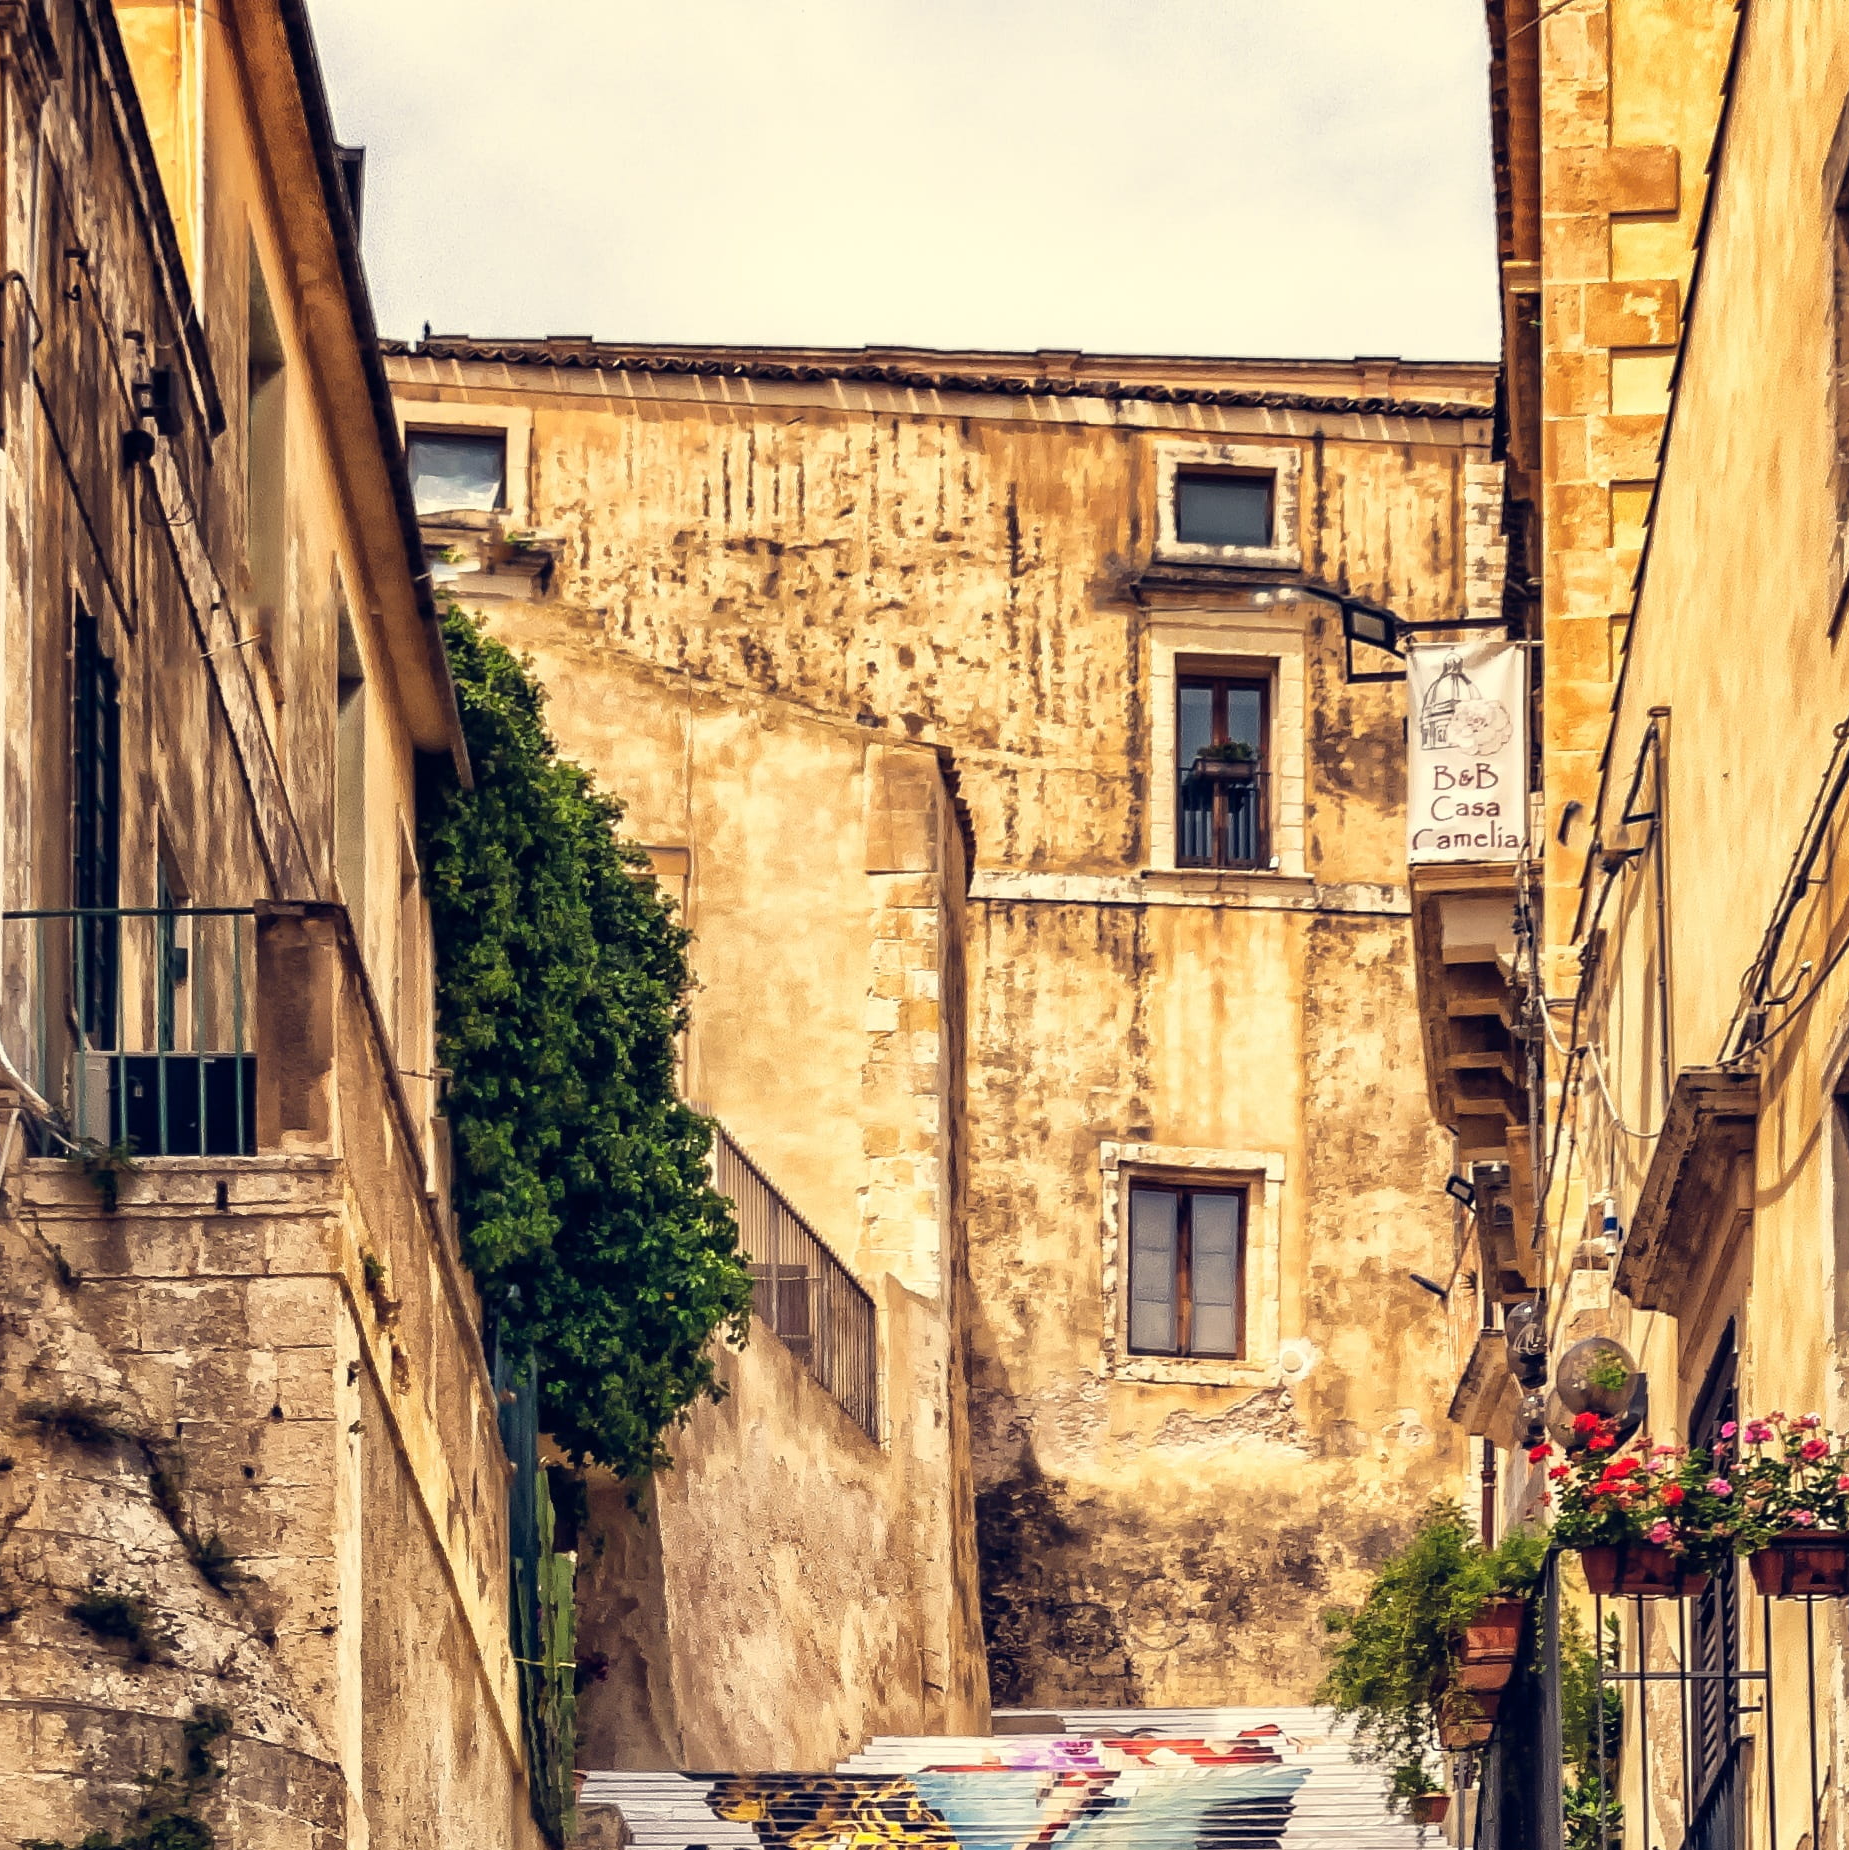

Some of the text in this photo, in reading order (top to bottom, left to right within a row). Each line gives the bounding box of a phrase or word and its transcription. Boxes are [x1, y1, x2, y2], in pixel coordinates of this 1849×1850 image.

[1433, 763, 1498, 790] B&B
[1431, 795, 1500, 821] Casa
[1412, 820, 1520, 850] Camelia
